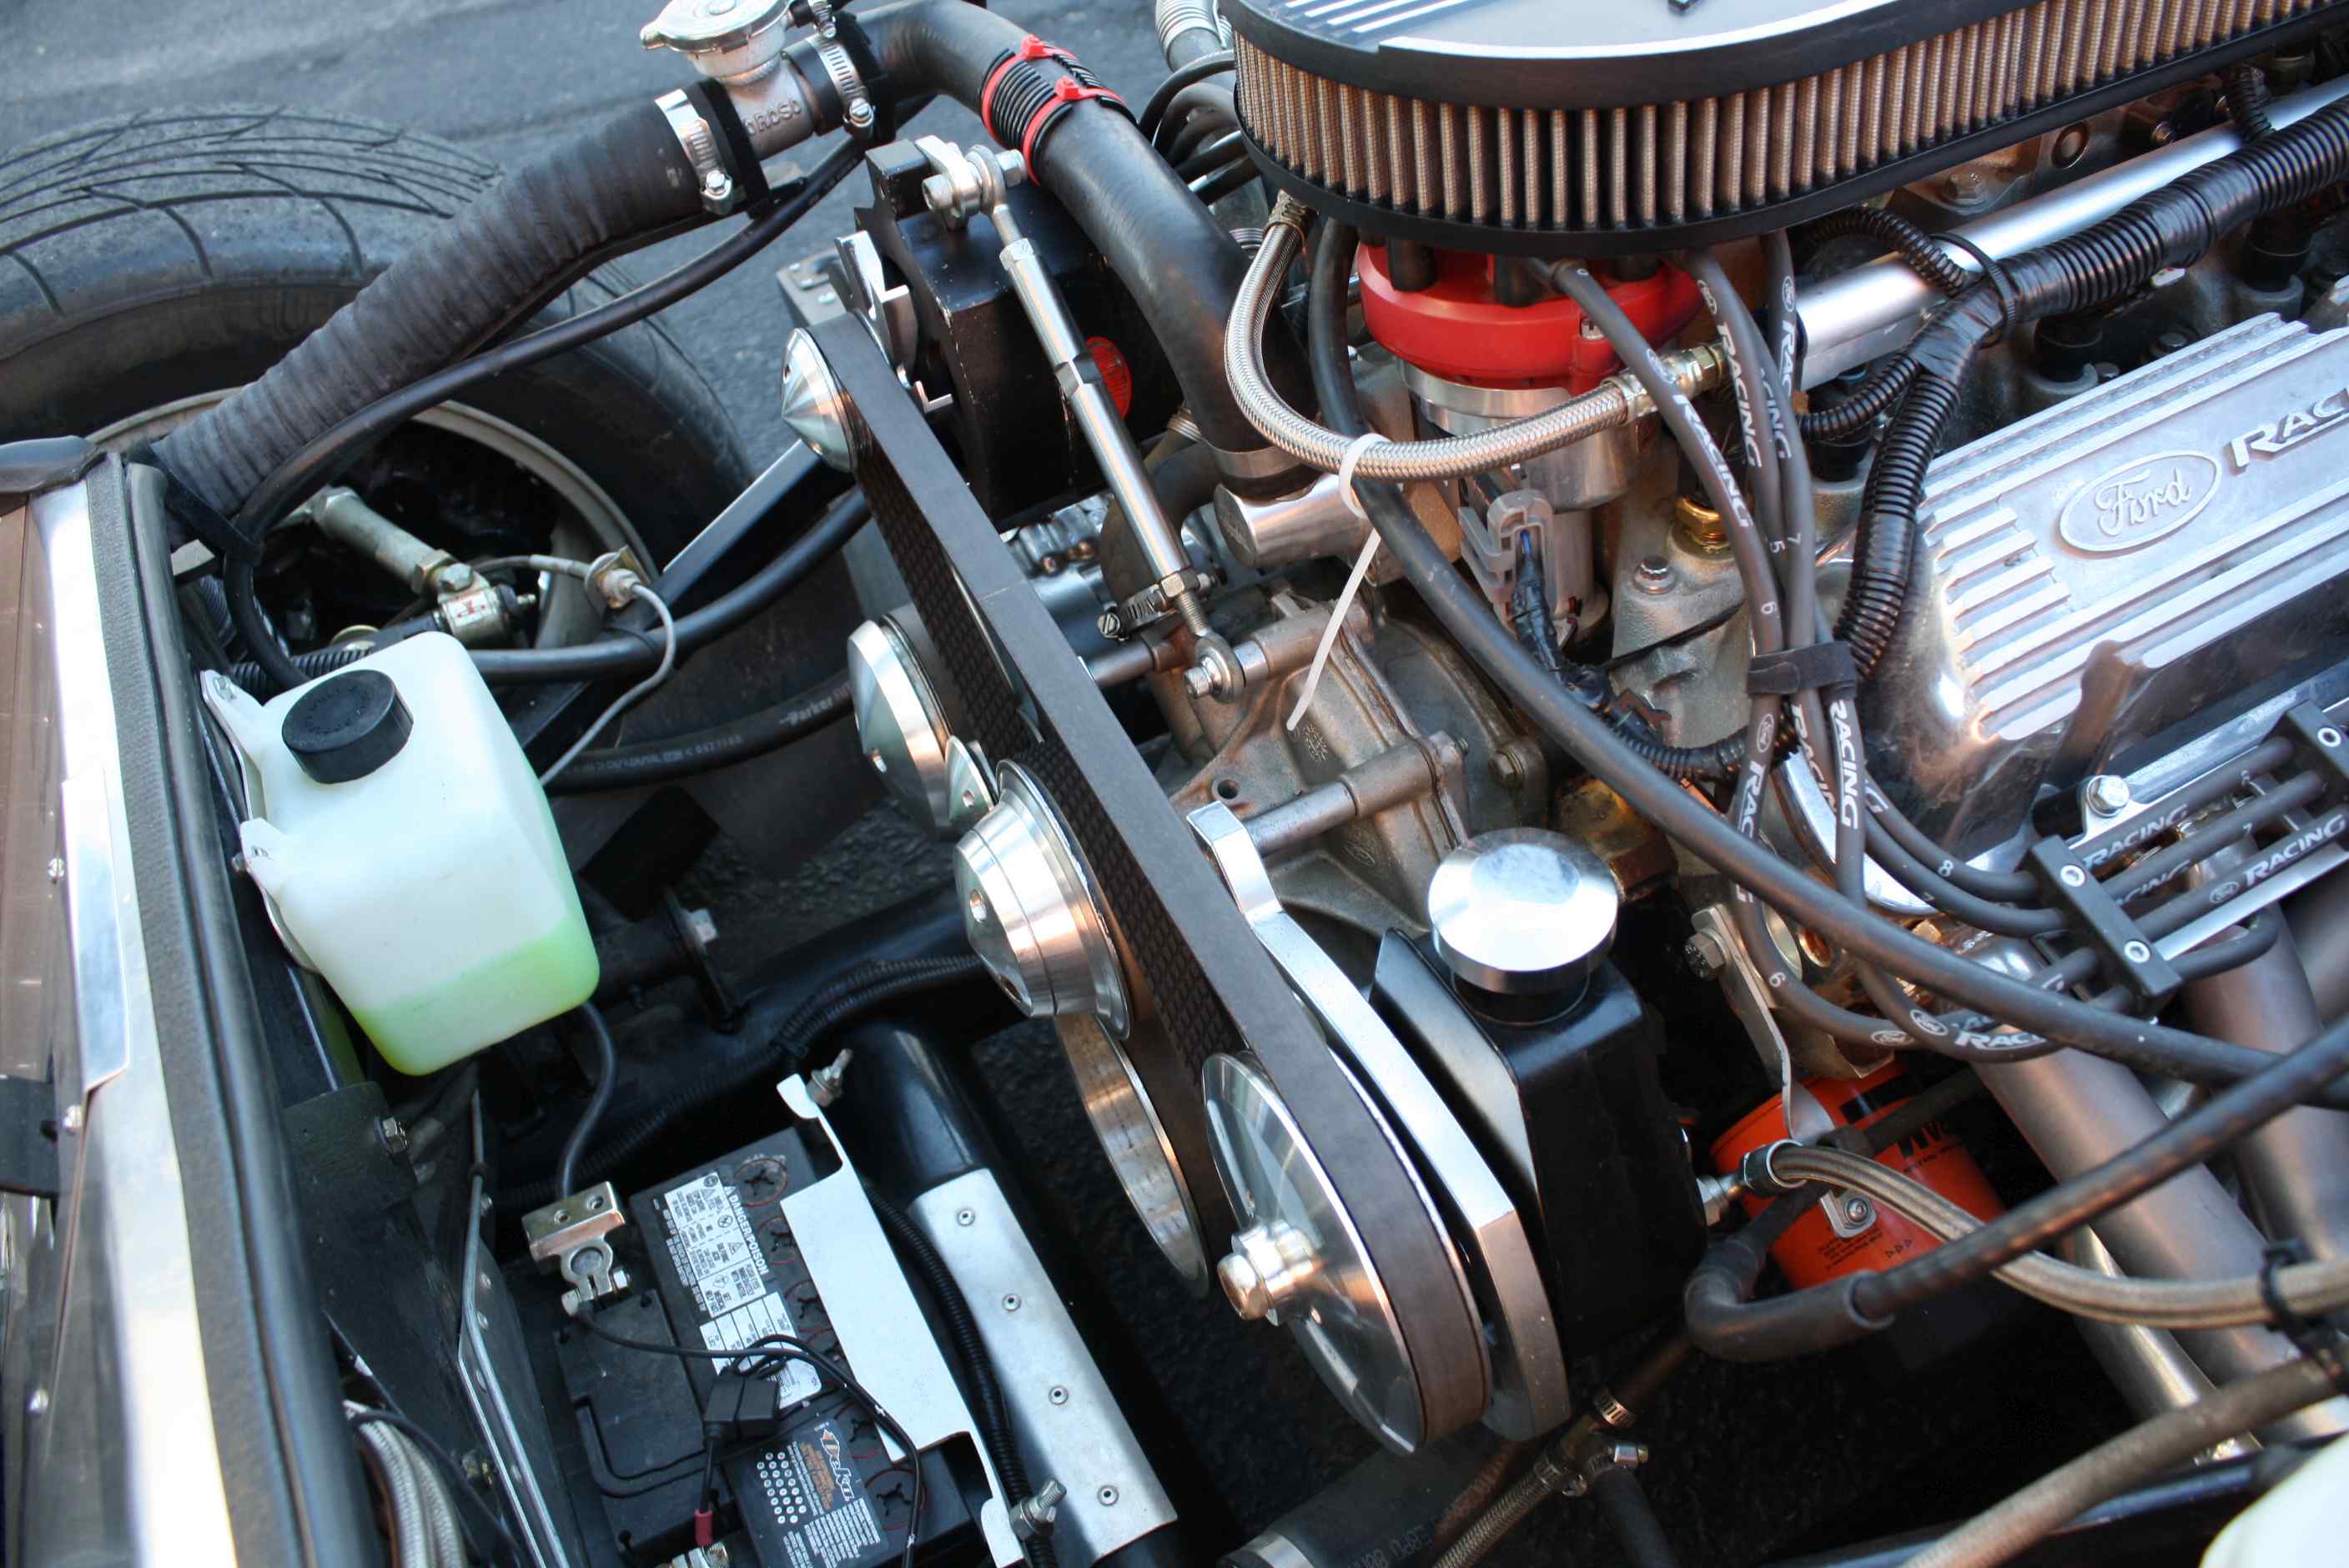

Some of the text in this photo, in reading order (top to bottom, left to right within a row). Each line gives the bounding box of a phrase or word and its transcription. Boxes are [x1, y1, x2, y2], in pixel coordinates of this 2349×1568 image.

[744, 99, 802, 134] OROSO
[1717, 322, 1762, 467] RACING
[1672, 395, 1754, 528] RACING
[2094, 467, 2192, 536] Ford
[1768, 540, 1786, 554] 5
[2244, 814, 2346, 887] RACING
[1937, 860, 1953, 877] 8
[1769, 972, 1785, 988] 6
[1955, 1031, 2047, 1049] RAC
